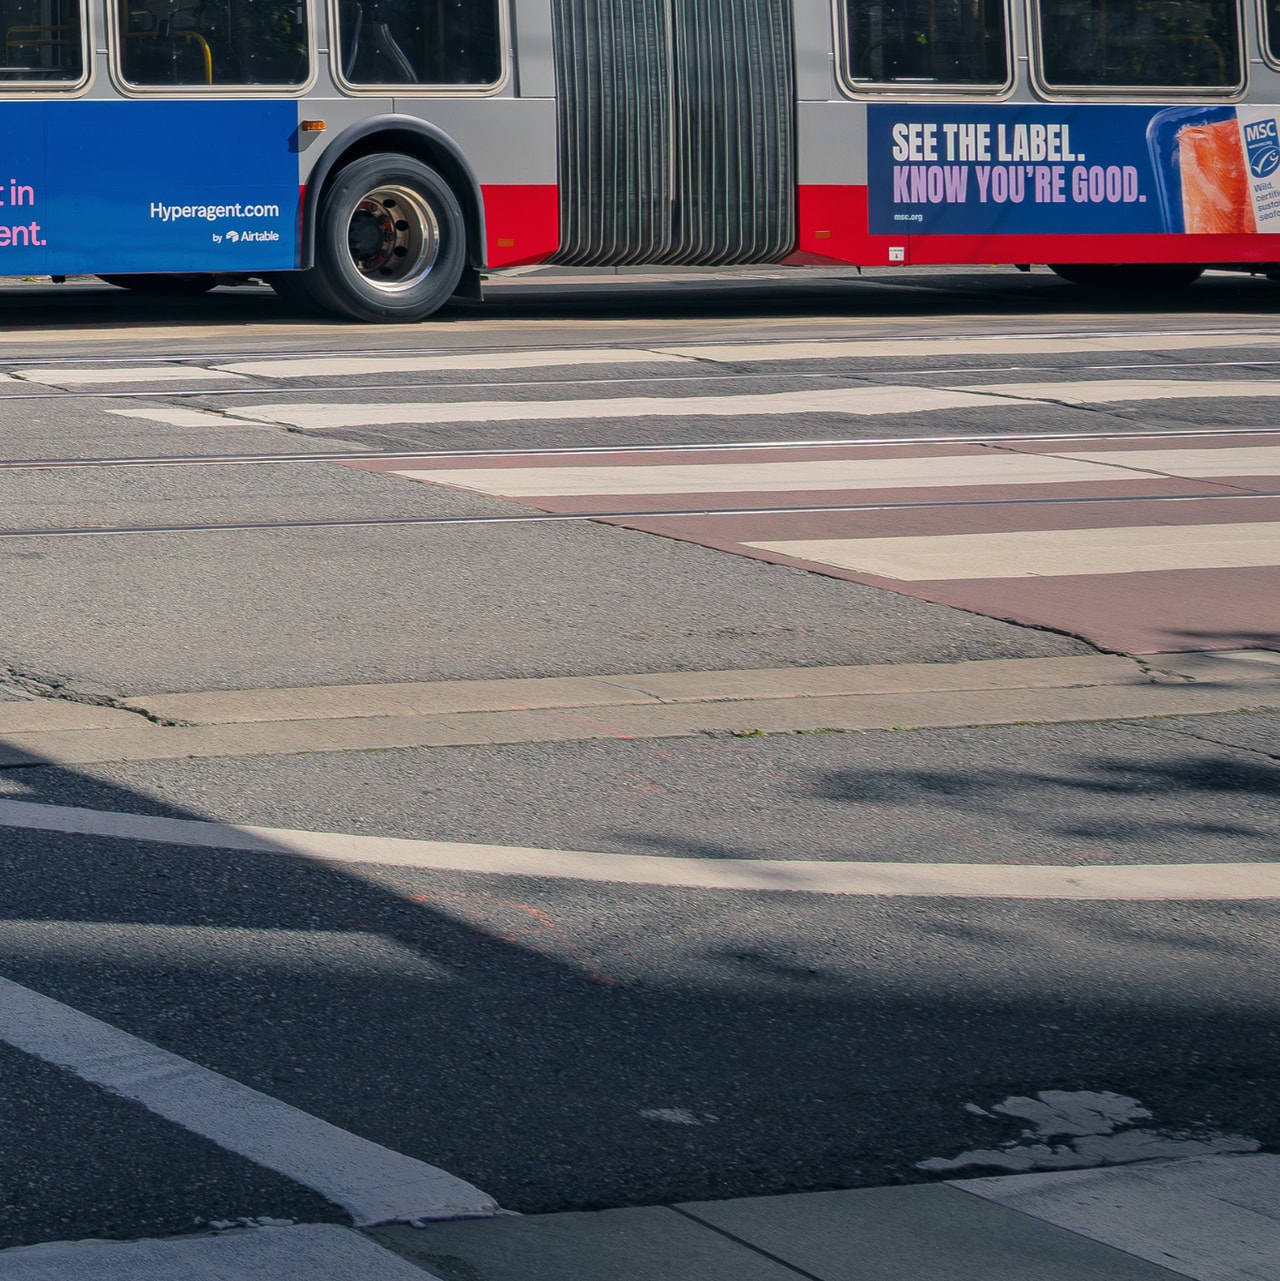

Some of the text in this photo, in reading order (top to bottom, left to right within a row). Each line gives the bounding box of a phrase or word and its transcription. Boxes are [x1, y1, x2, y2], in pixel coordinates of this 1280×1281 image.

[1246, 121, 1276, 142] MSC
[892, 123, 1086, 162] SEE THE LABEL.
[10, 178, 34, 206] in
[893, 165, 1147, 203] KNOW YOU’RE GOOD.
[1254, 182, 1275, 193] Wild,
[150, 202, 280, 222] Hyperagent.com
[212, 230, 280, 244] by Airtable
